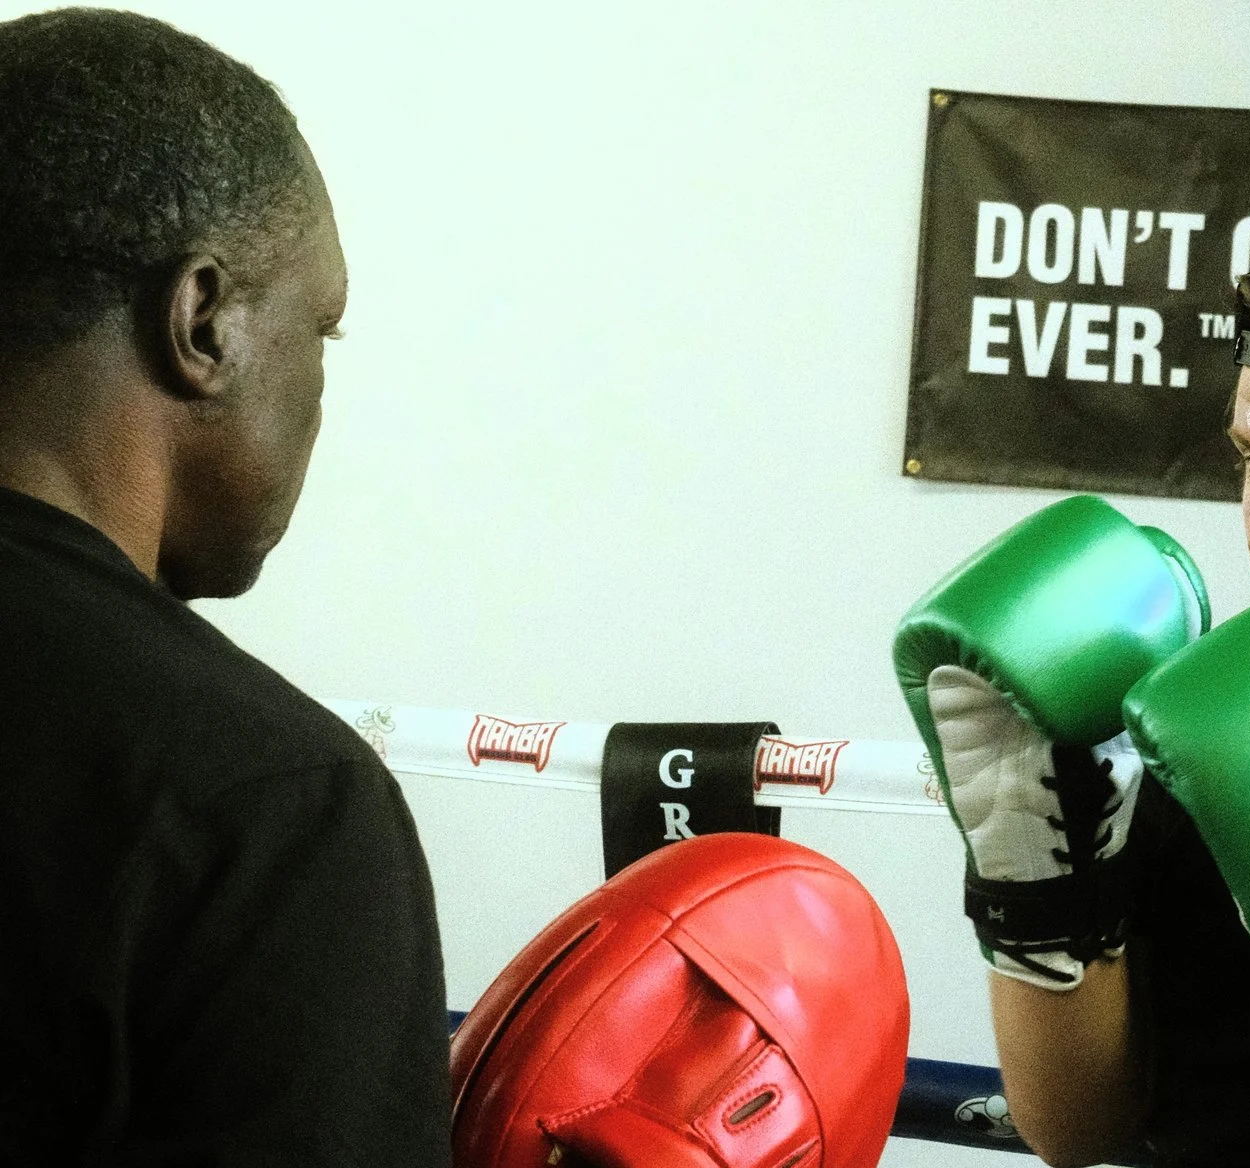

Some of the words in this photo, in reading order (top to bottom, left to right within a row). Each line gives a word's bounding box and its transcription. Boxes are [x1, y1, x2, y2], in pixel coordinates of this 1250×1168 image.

[975, 201, 1205, 291] DON'T
[968, 296, 1190, 388] EVER.
[467, 714, 568, 773] MAMBA
